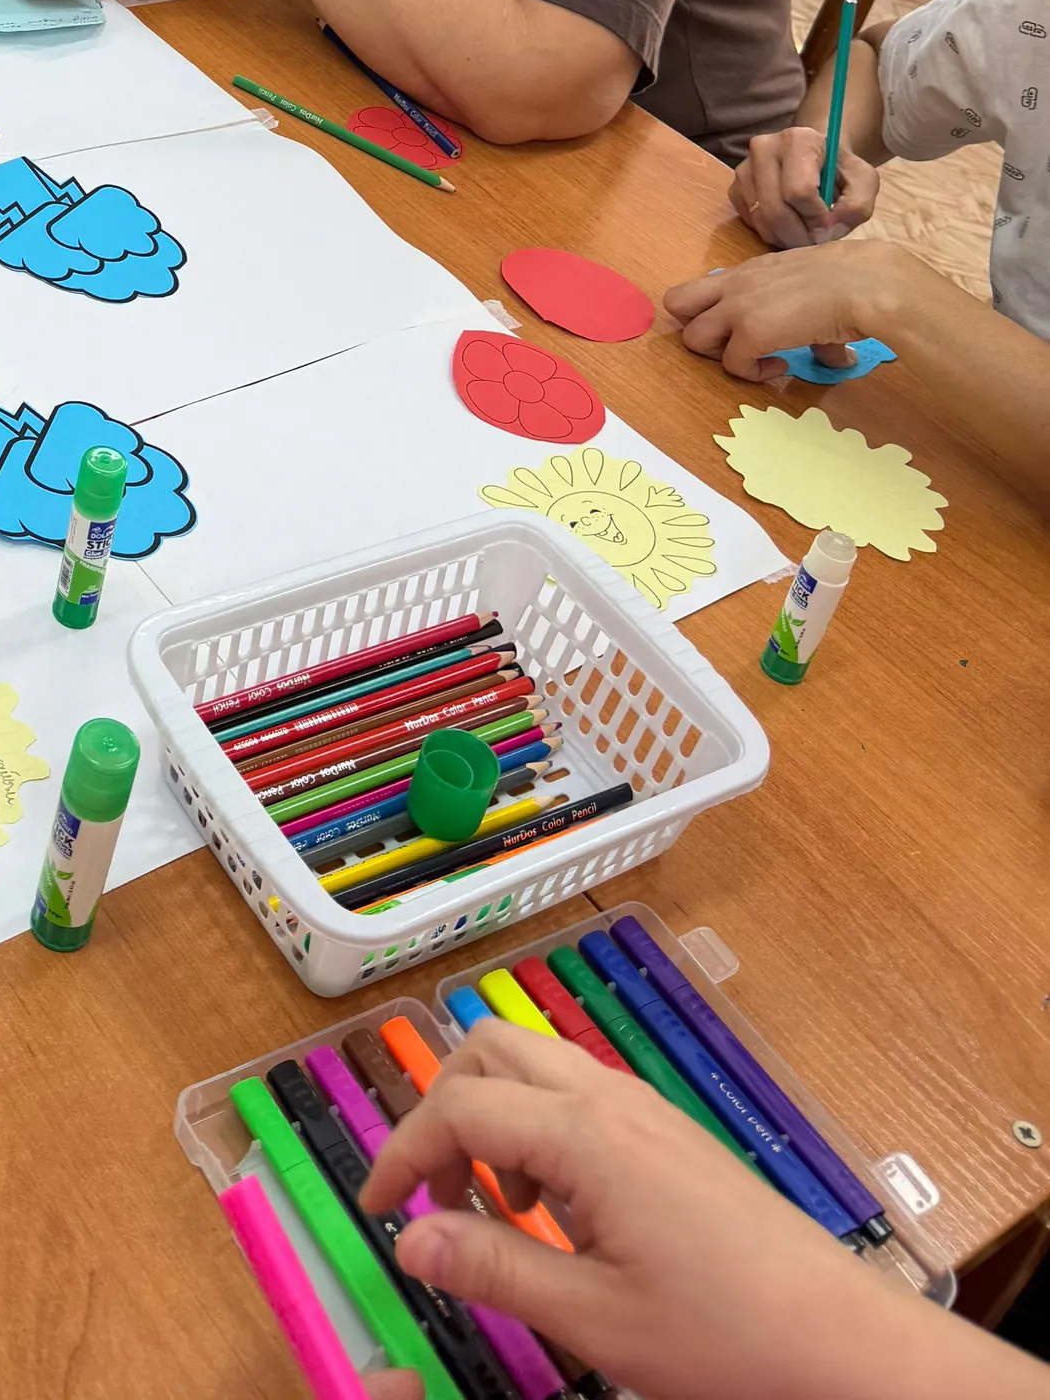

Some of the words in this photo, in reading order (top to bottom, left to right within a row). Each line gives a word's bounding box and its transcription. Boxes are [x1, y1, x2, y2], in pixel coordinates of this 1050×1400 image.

[257, 87, 277, 102] Pencil
[279, 98, 297, 112] Color
[299, 109, 324, 125] NurDos
[392, 92, 410, 112] NurDos
[409, 109, 424, 126] Color
[422, 122, 439, 138] Pencil
[87, 538, 111, 550] STIC
[276, 672, 312, 691] NurDos
[247, 686, 273, 701] Color
[212, 697, 241, 715] Pencil
[404, 712, 440, 731] NurDos
[443, 703, 468, 719] Color
[471, 690, 499, 708] Pencil
[319, 759, 357, 776] NurDos
[289, 774, 317, 788] Color
[501, 827, 538, 849] NurDos
[541, 814, 568, 833] Color
[571, 801, 598, 822] Pencil
[315, 827, 341, 844] Color
